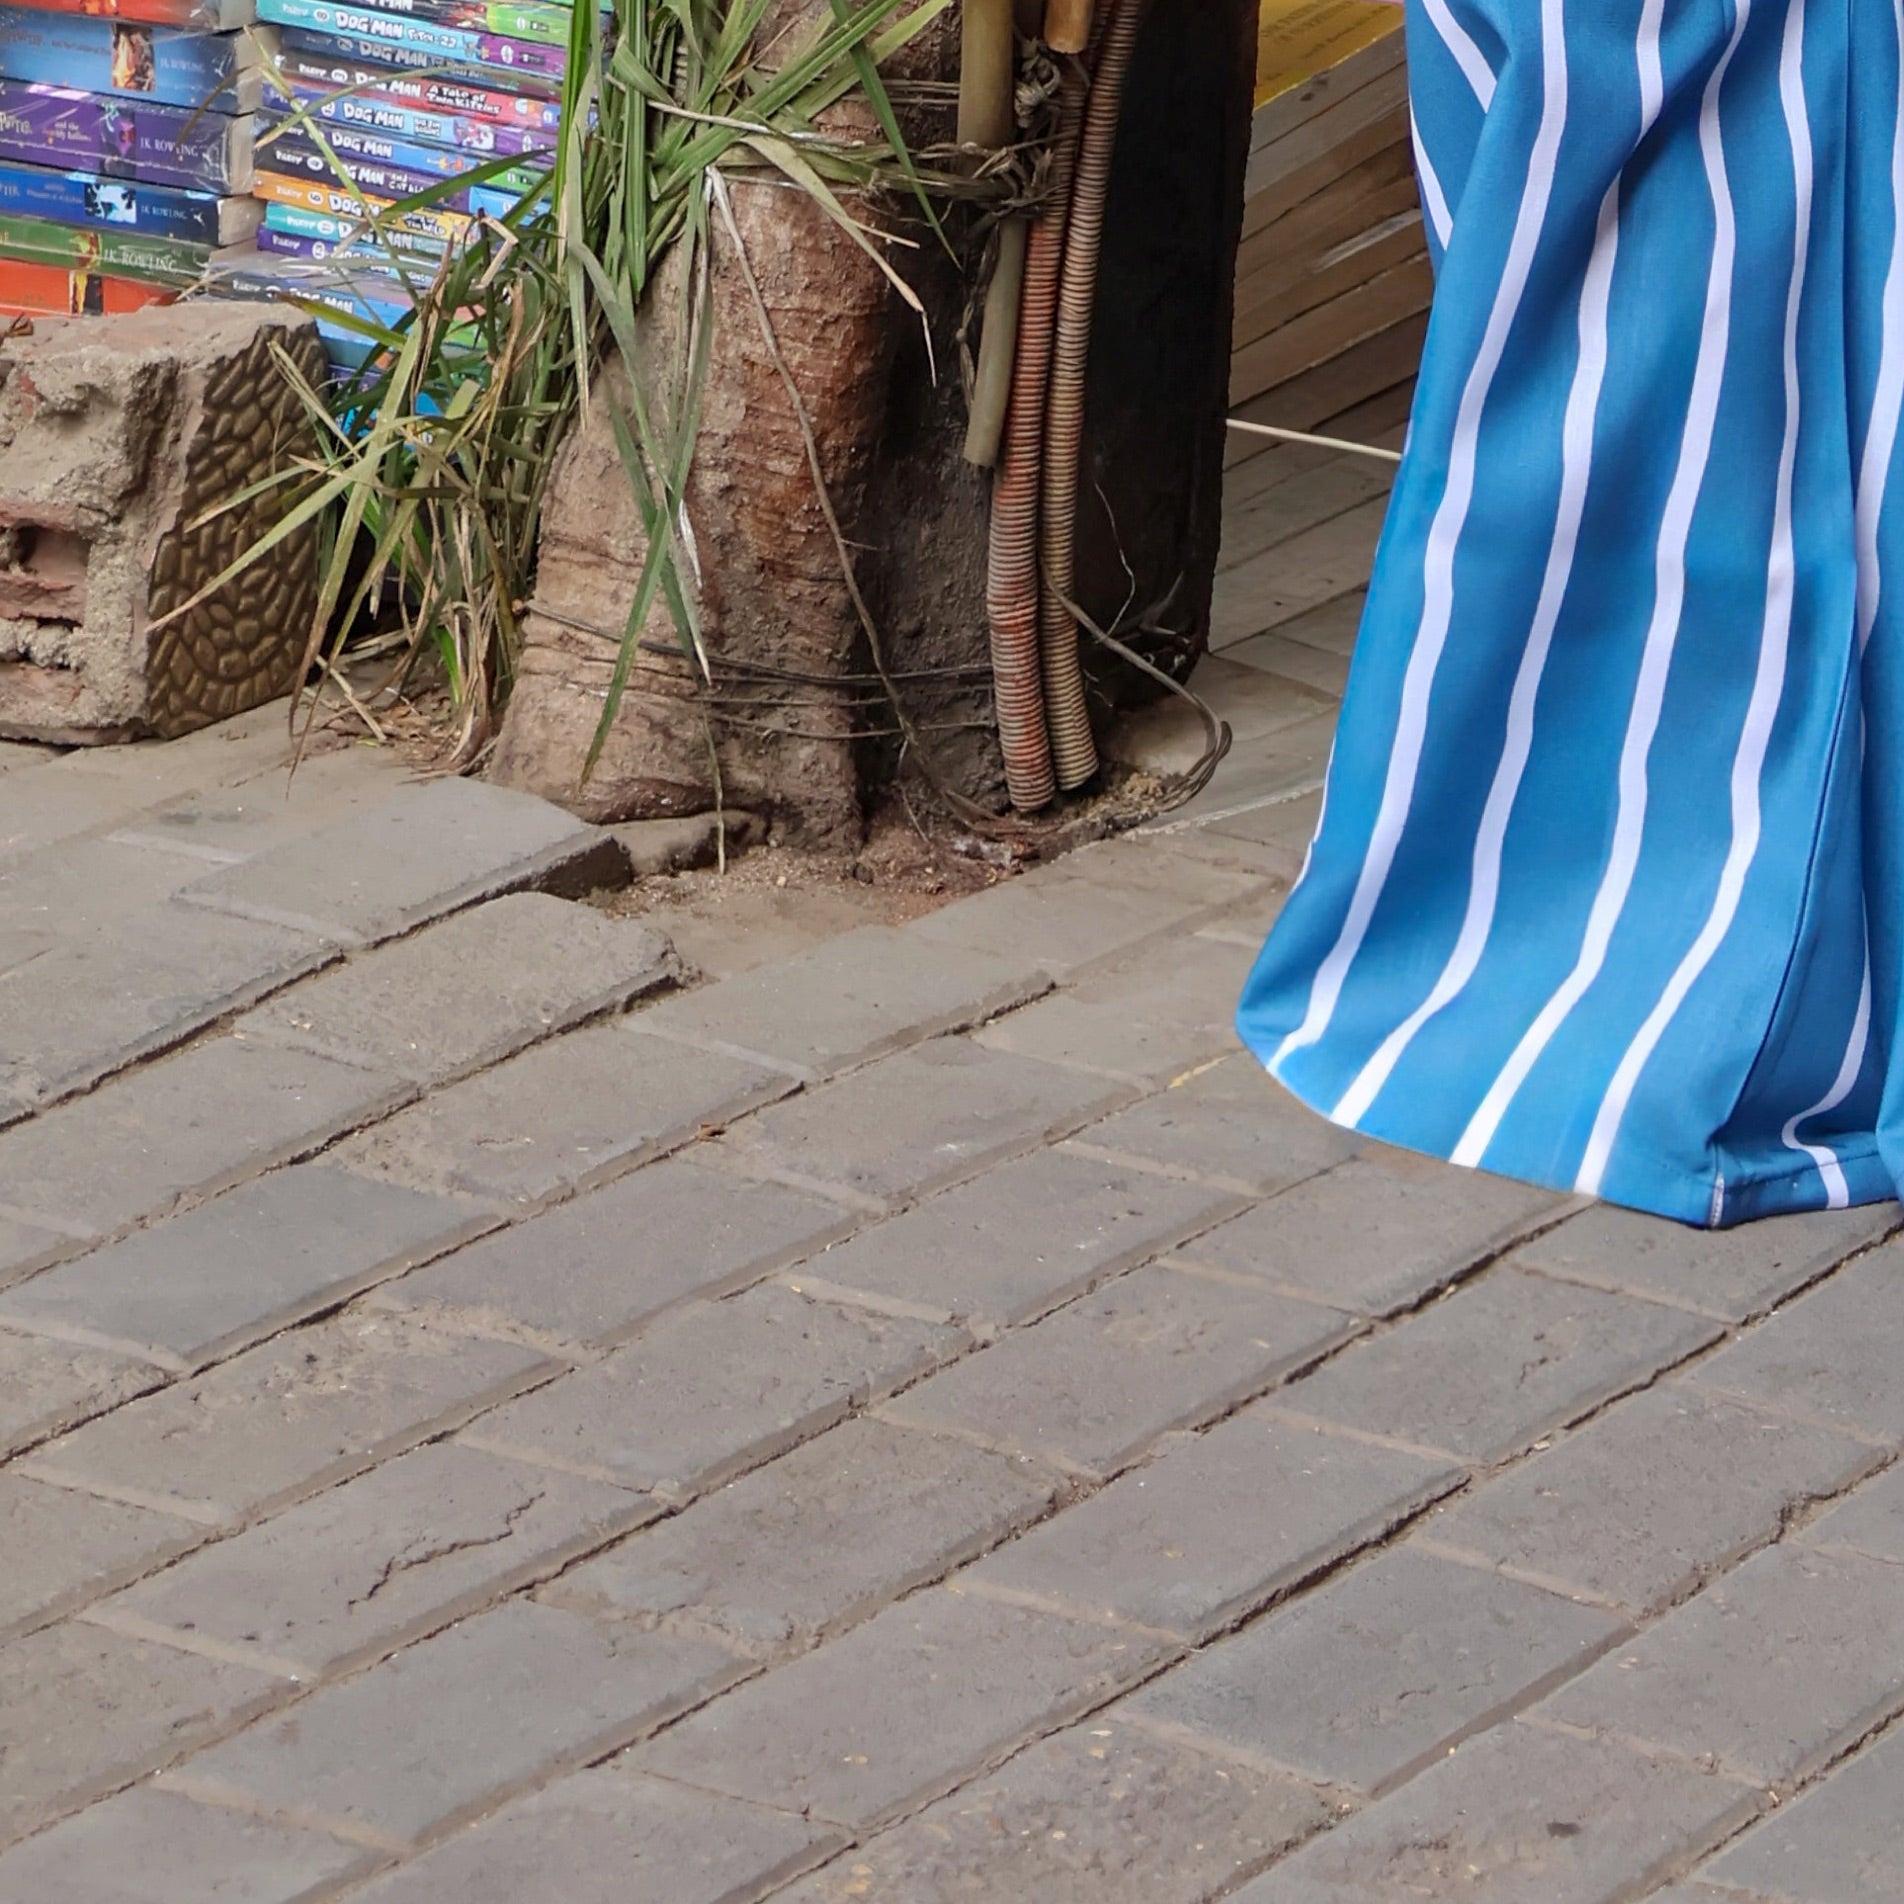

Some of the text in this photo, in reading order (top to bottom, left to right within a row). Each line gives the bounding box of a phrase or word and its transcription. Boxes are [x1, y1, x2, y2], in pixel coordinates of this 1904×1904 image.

[335, 10, 404, 39] DOG MAN
[359, 40, 392, 61] DOG
[394, 47, 428, 68] MAN
[389, 79, 421, 98] MAN
[442, 86, 468, 98] Tale
[471, 89, 486, 101] of
[343, 102, 372, 124] DOG
[374, 108, 404, 129] MAN
[332, 132, 393, 158] DOG MAN
[357, 165, 385, 185] MAN
[328, 193, 363, 216] DOG
[323, 293, 353, 314] MAN
